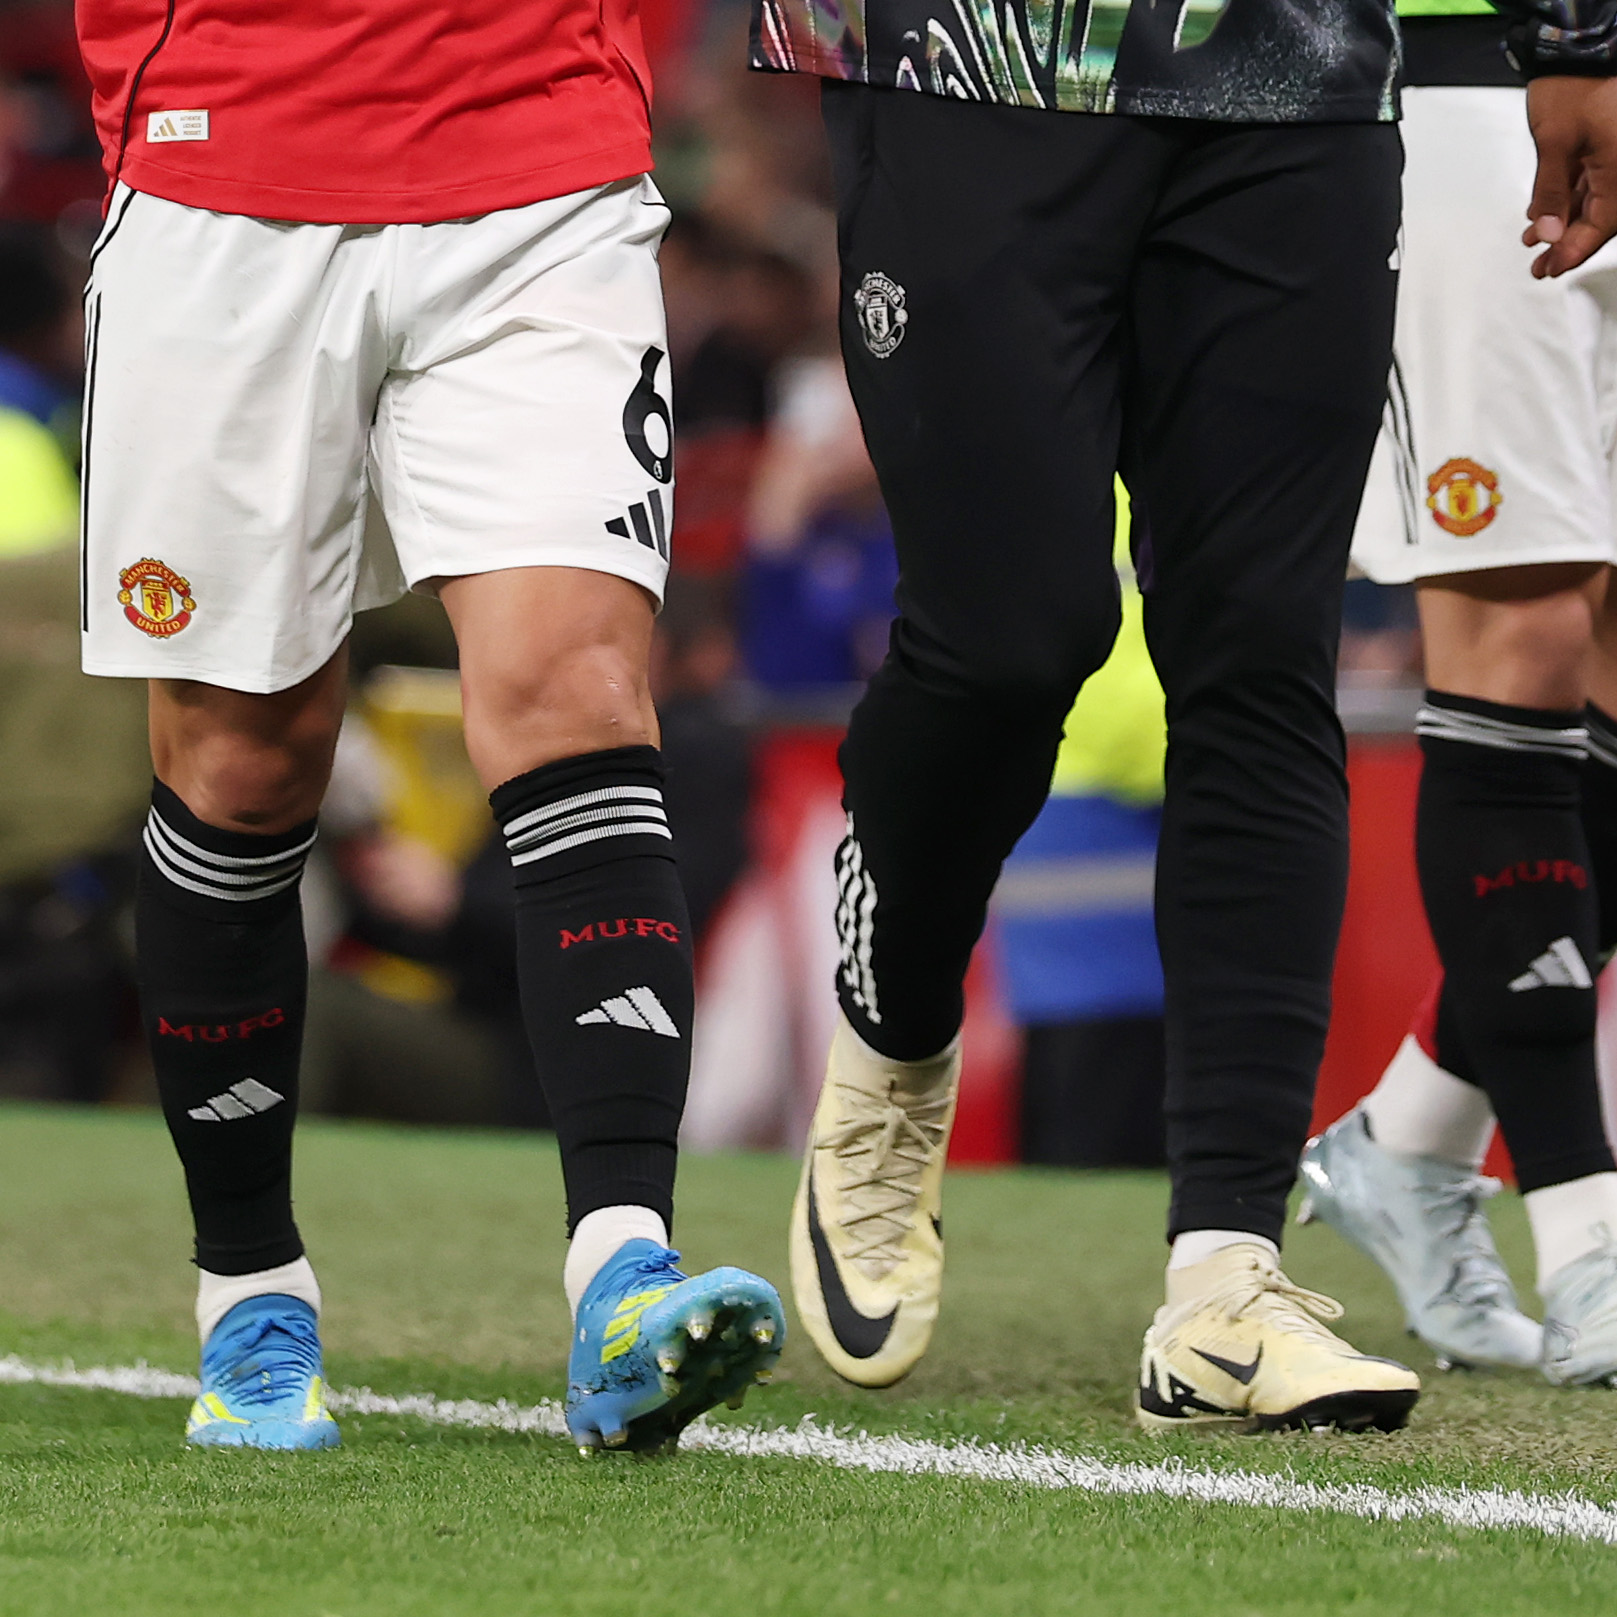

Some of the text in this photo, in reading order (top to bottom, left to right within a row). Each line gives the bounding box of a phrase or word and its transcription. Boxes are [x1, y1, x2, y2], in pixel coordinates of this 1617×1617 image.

[622, 344, 673, 485] 6
[124, 563, 186, 593] MANCHESTER
[136, 616, 181, 633] UNITED
[558, 916, 681, 950] MUFC
[157, 1006, 286, 1043] MUFC
